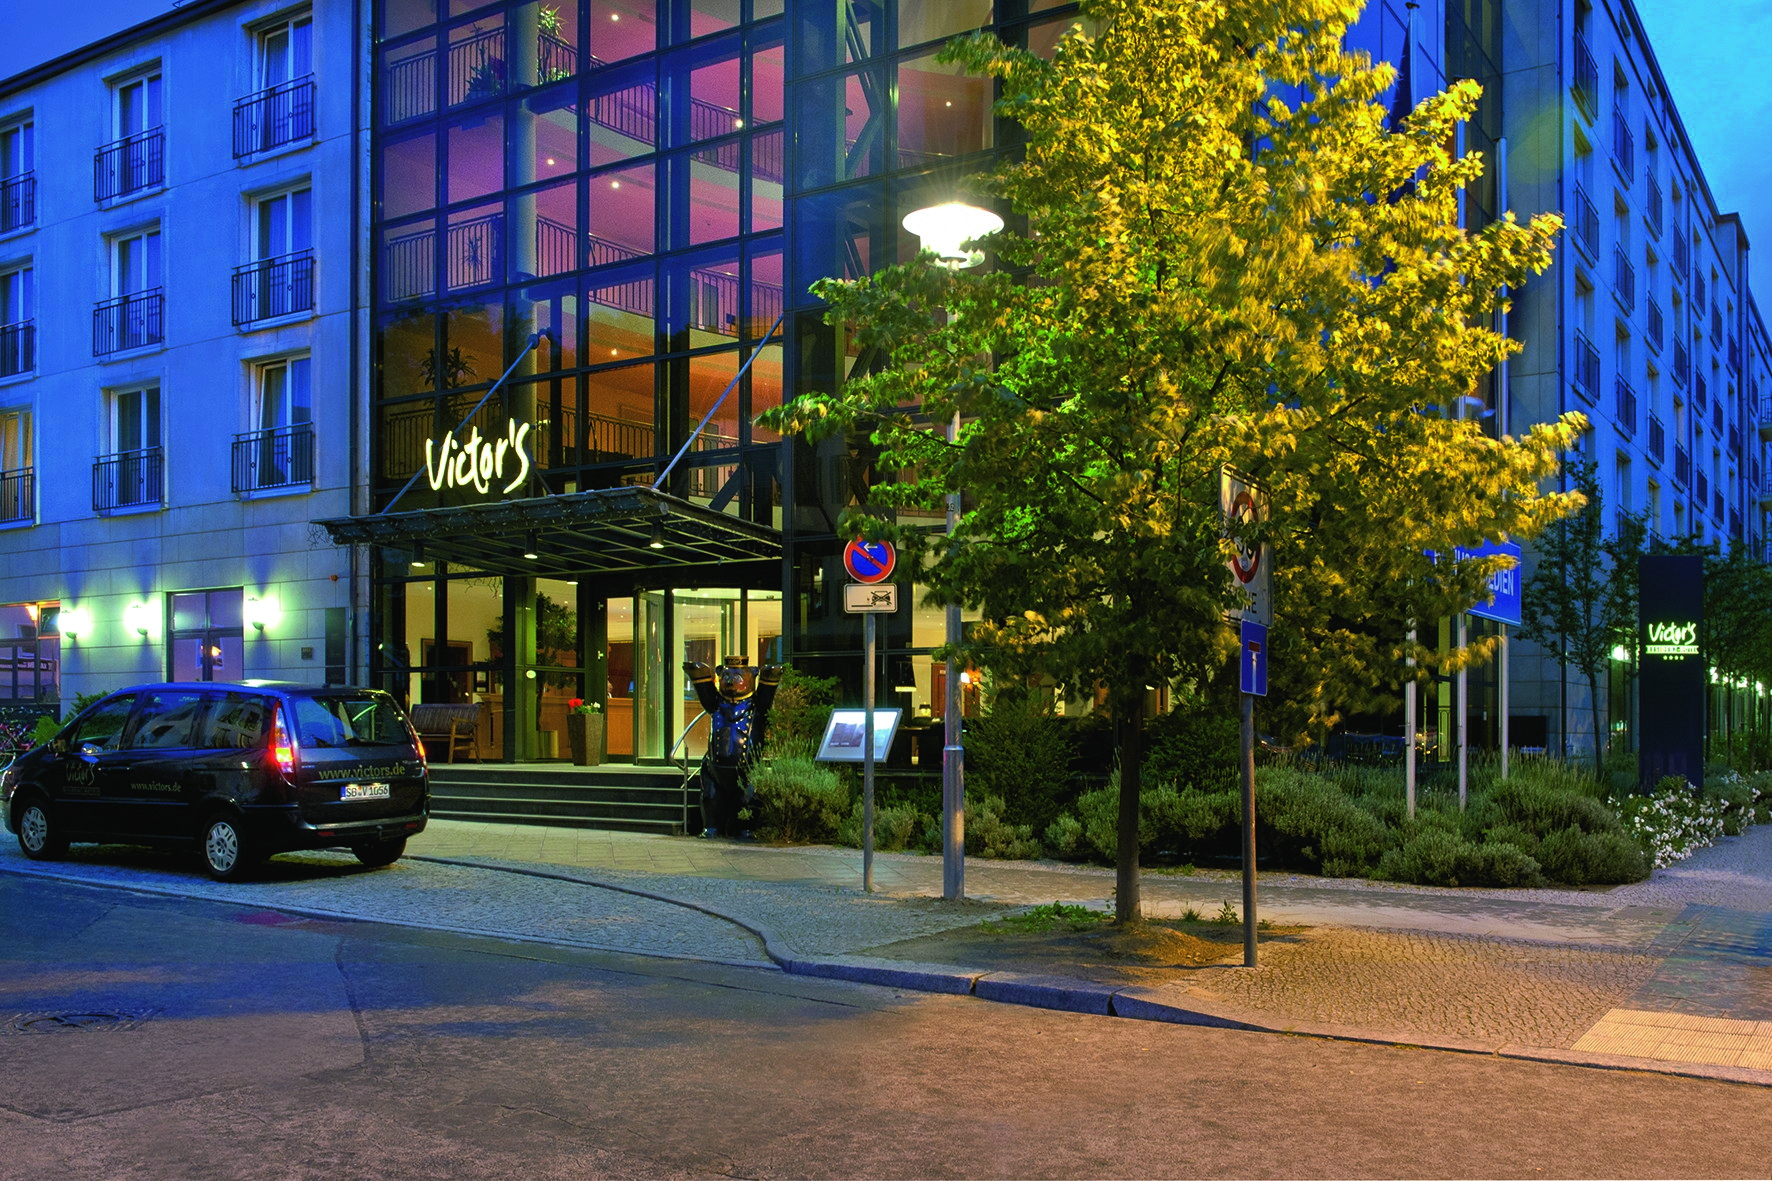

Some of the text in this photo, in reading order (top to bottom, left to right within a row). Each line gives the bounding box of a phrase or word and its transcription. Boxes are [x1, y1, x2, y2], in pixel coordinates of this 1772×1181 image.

[319, 762, 405, 779] www.victors.de
[131, 781, 181, 792] www.victors.de
[346, 787, 357, 797] SB
[362, 786, 368, 796] V
